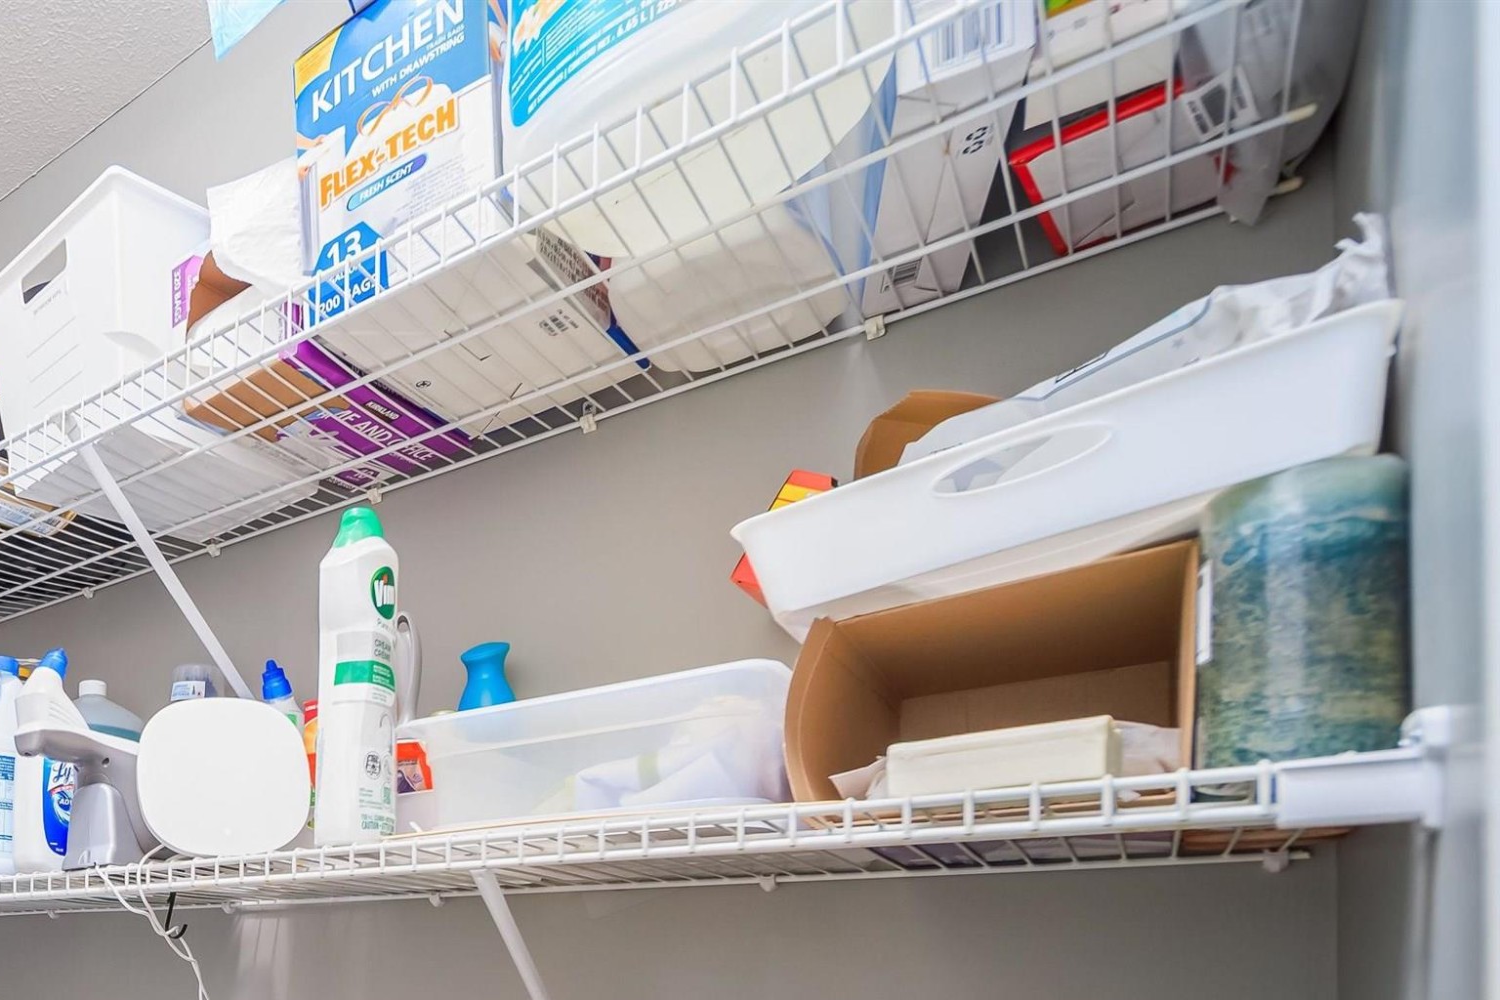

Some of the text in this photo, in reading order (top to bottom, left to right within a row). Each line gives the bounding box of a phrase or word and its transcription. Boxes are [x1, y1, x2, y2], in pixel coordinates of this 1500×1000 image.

[312, 0, 465, 123] KITCHEN
[371, 33, 465, 97] WITH DRAWSTRING
[320, 98, 456, 208] FLEX-TECH
[359, 176, 384, 201] FRESH
[384, 162, 414, 186] SCENT
[326, 230, 362, 265] 13
[365, 400, 401, 421] KIRKLAND
